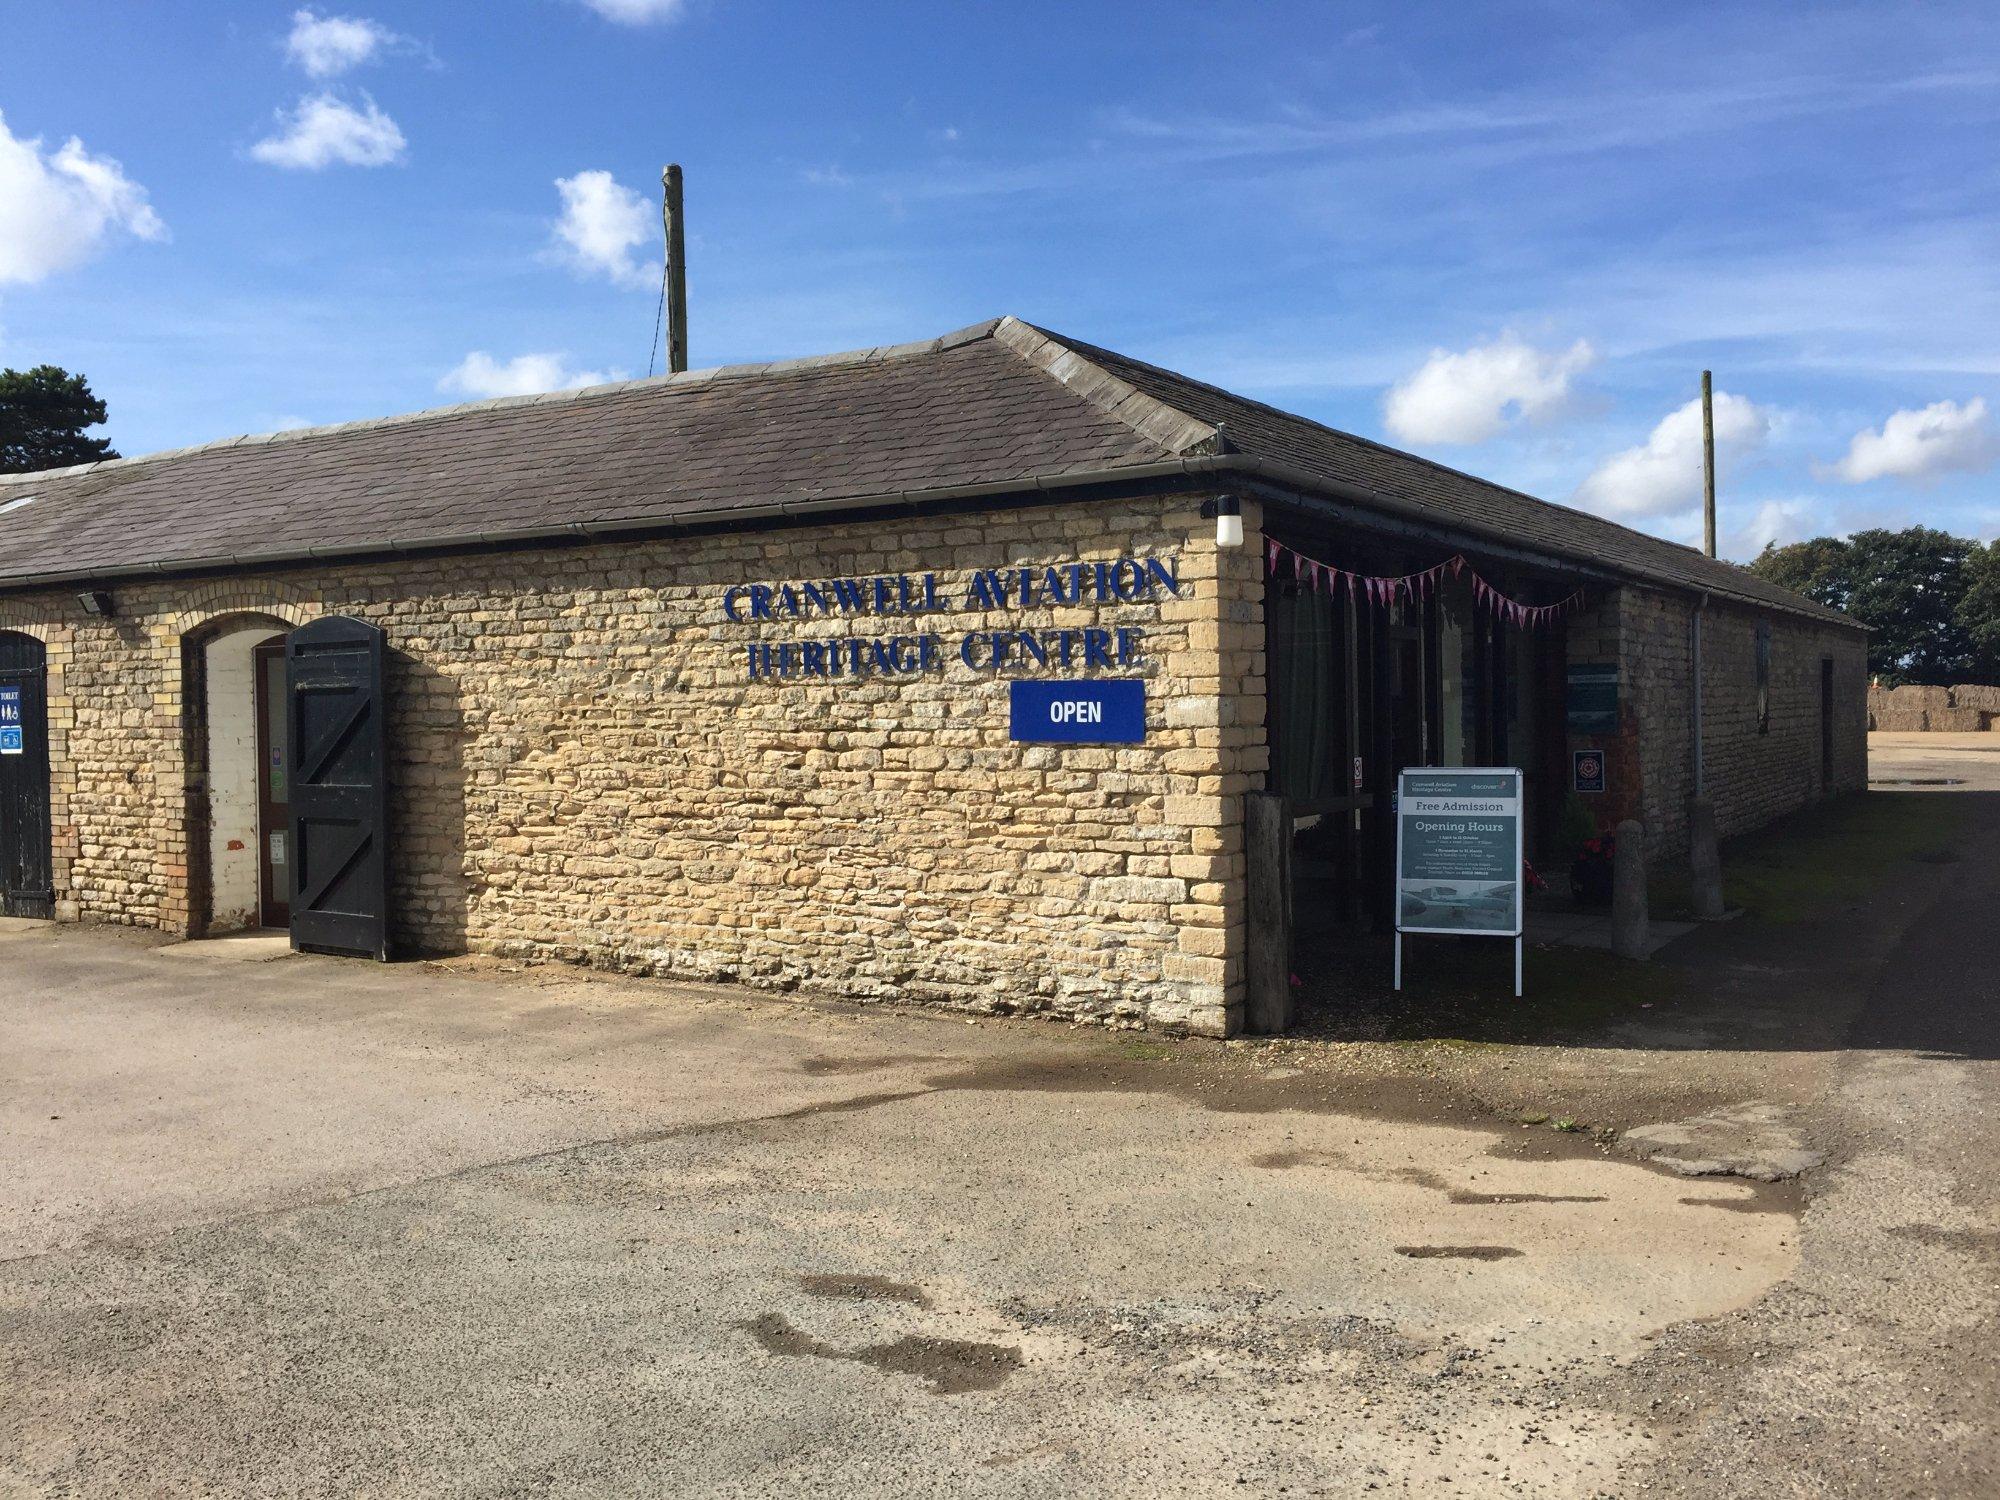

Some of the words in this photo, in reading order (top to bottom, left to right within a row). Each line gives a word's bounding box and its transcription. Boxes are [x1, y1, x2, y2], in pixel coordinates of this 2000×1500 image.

[724, 573, 947, 622] CRANWELL
[965, 556, 1180, 612] AVIATION
[747, 632, 943, 679] HERITAGE
[961, 627, 1145, 671] CENTRE
[1050, 701, 1102, 723] OPEN
[1416, 802, 1440, 811] Free
[1442, 802, 1504, 811] Admission
[1415, 821, 1465, 833] Opening
[1468, 822, 1504, 832] Hours
